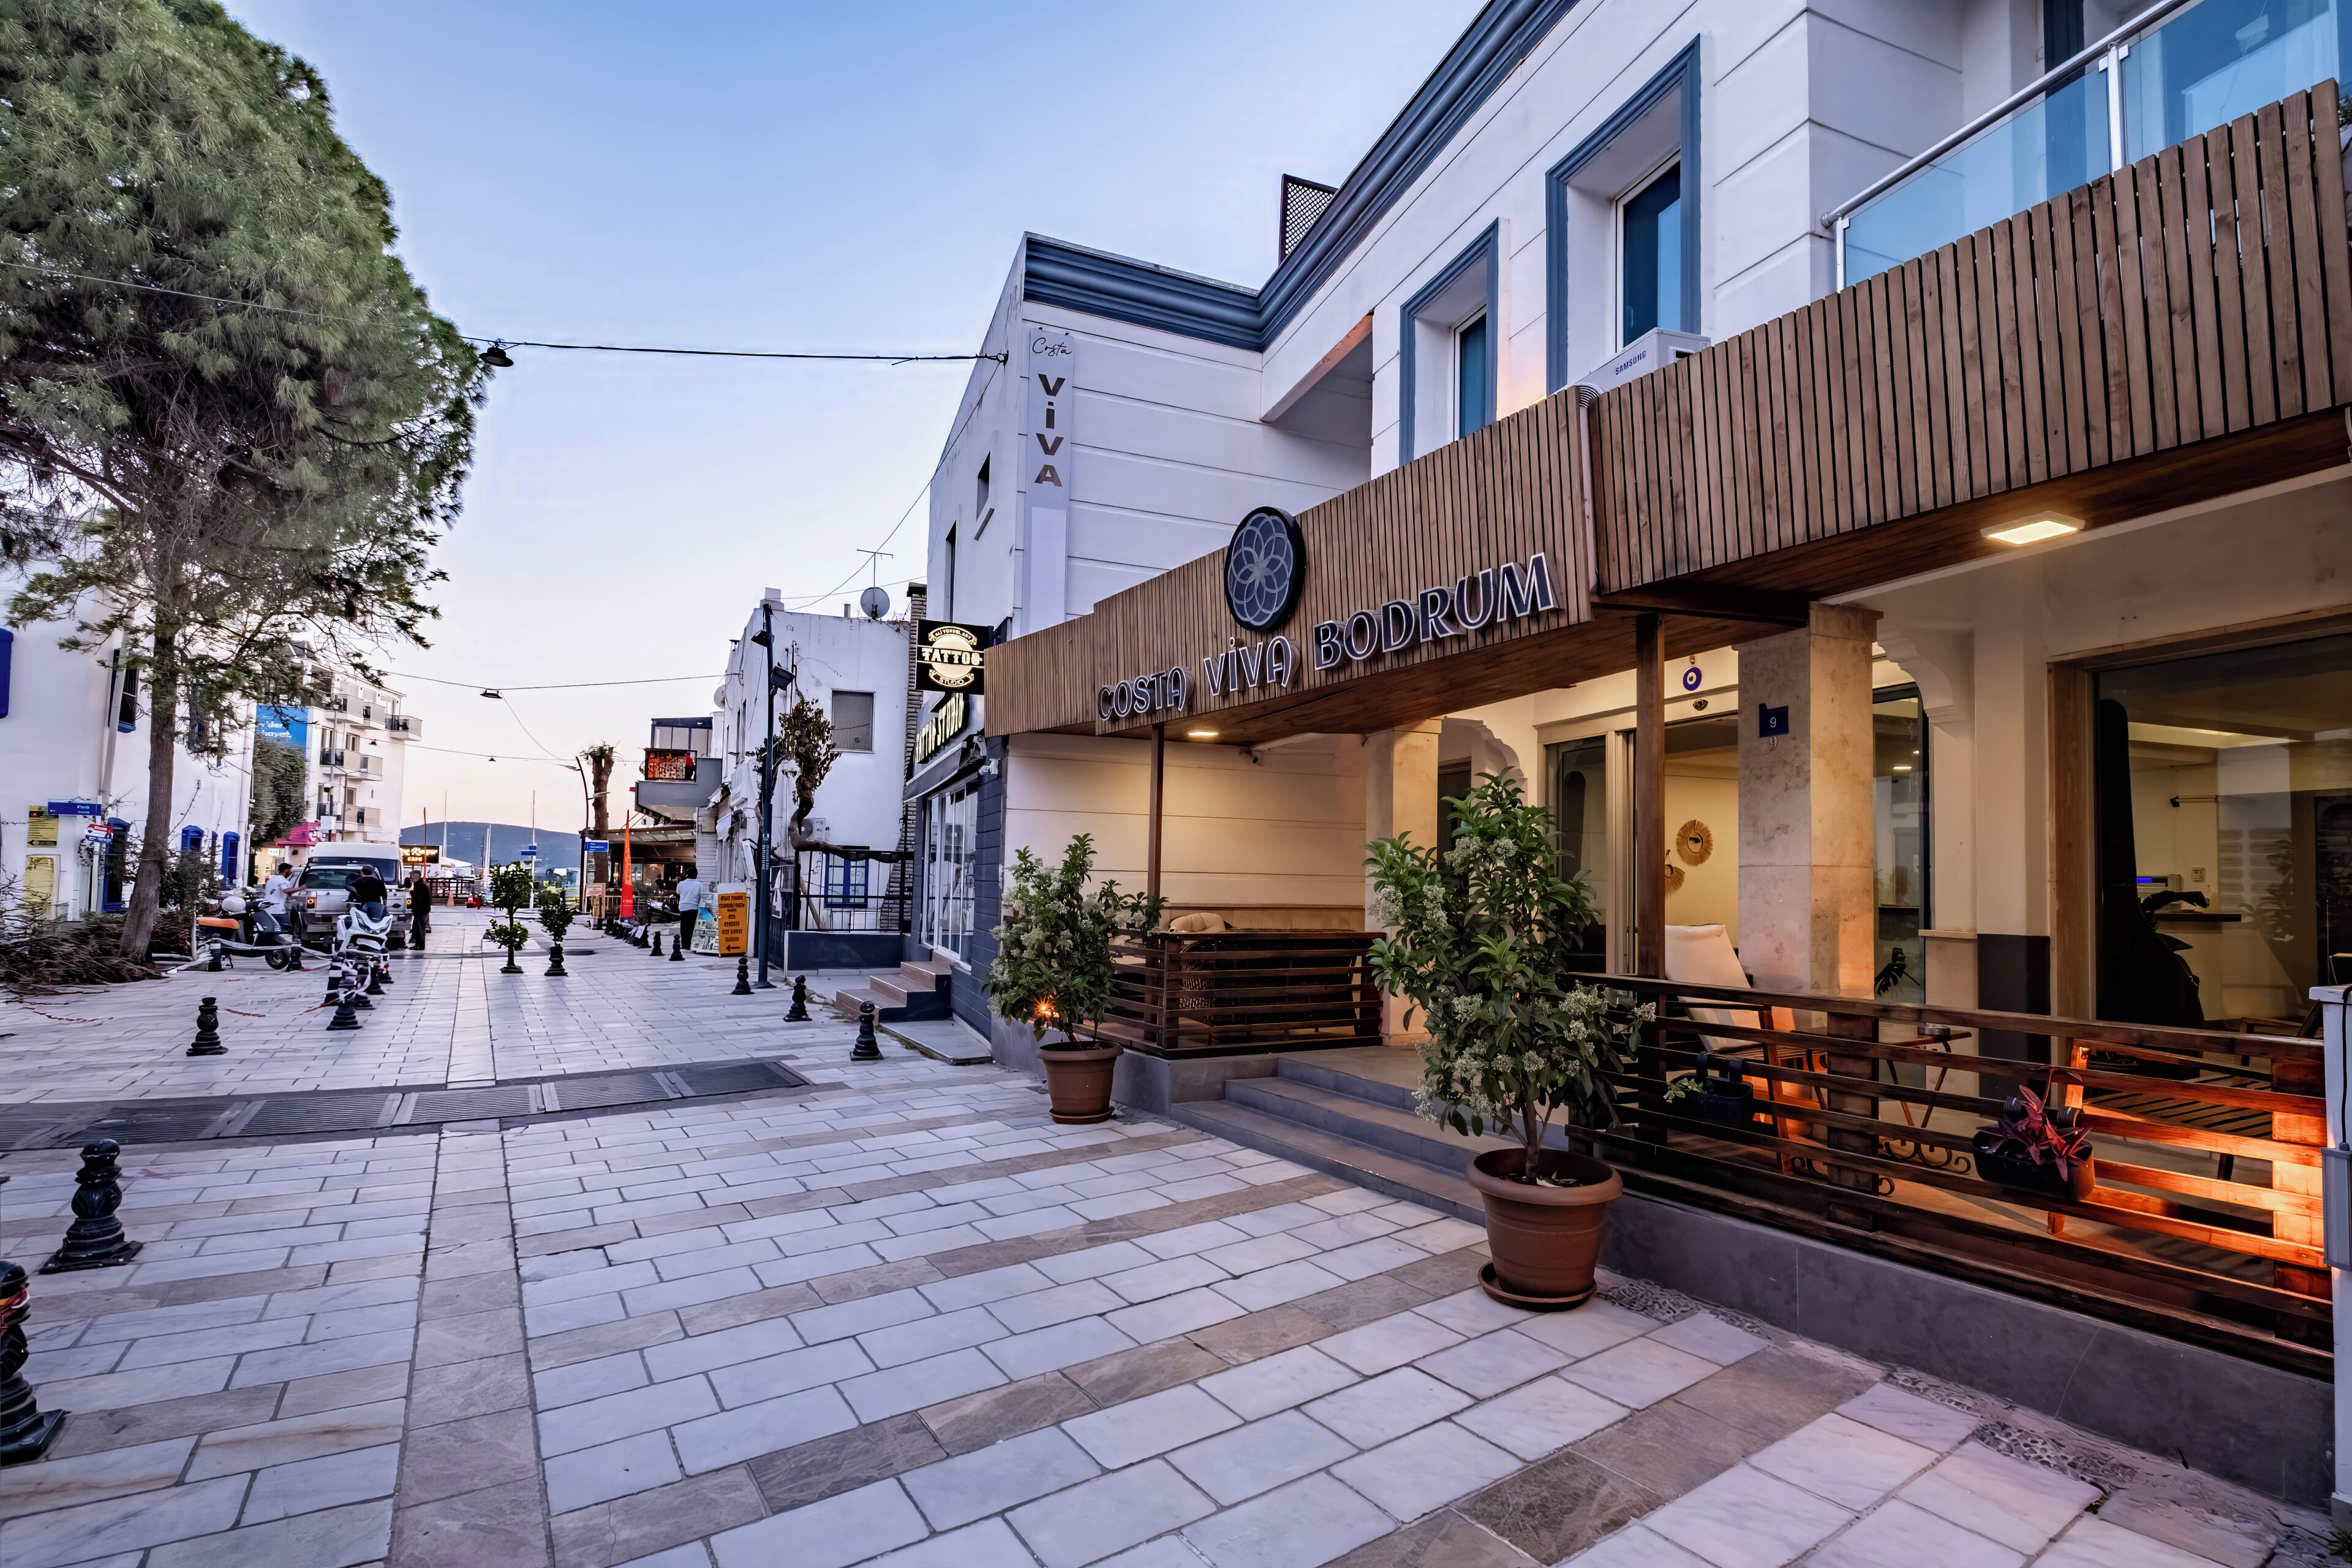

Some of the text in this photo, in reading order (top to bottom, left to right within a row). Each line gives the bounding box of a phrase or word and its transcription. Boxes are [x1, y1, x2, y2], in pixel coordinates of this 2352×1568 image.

[1032, 337, 1072, 356] Costa
[1615, 350, 1646, 375] SAMSUNG
[1098, 666, 1188, 720] COSTA
[1314, 552, 1556, 671] BODRUM
[921, 647, 982, 666] TATTOO
[938, 677, 964, 685] STUDIO
[1770, 717, 1777, 728] 9
[1770, 736, 1777, 750] 9
